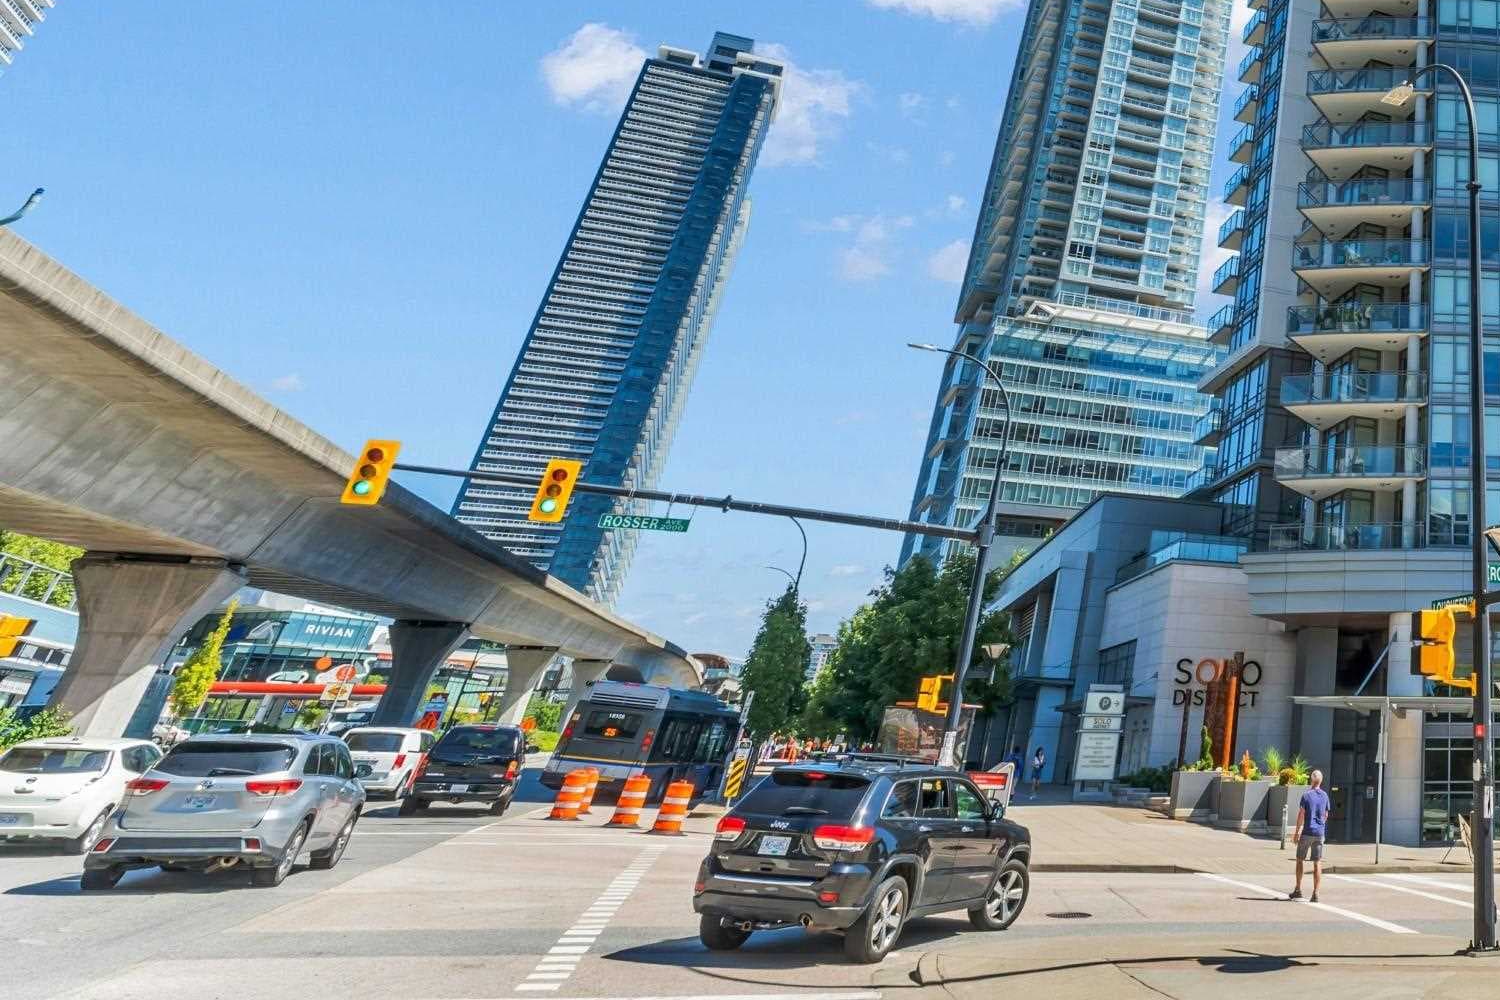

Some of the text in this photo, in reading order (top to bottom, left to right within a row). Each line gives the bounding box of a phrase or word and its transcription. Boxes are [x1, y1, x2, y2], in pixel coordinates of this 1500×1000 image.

[603, 516, 659, 529] ROSSER
[304, 624, 355, 638] RIVIAN
[1174, 658, 1262, 686] SOO
